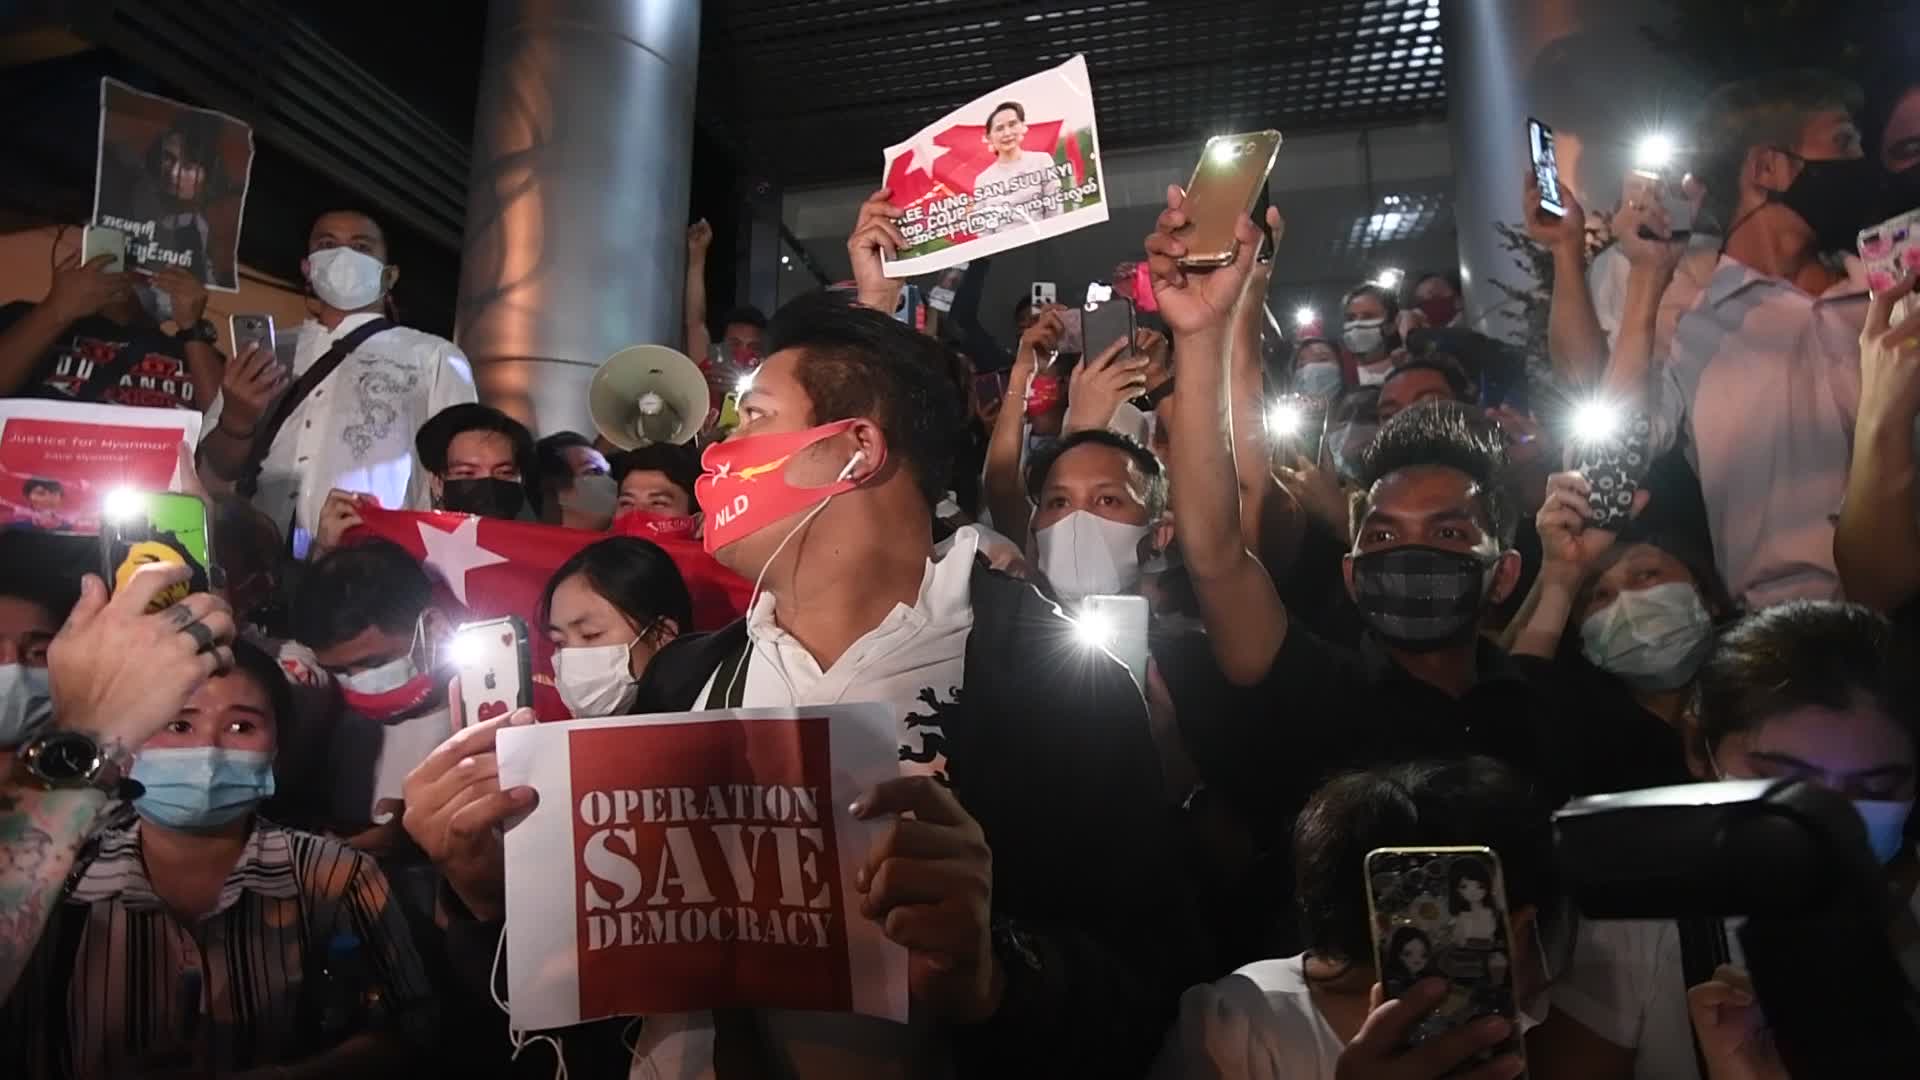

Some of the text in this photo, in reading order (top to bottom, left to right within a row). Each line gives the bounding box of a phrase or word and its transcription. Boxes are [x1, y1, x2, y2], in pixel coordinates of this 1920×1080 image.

[929, 194, 968, 216] AUNG
[974, 181, 1005, 202] SAN
[1010, 172, 1041, 193] SUU
[1046, 163, 1073, 183] KYI
[900, 207, 967, 239] top COUP
[8, 434, 172, 451] Justice for Myanmar
[715, 495, 749, 530] NLD
[580, 785, 819, 826] OPERATION
[583, 824, 832, 912] SAVE
[586, 907, 833, 950] DEMOCRACY
